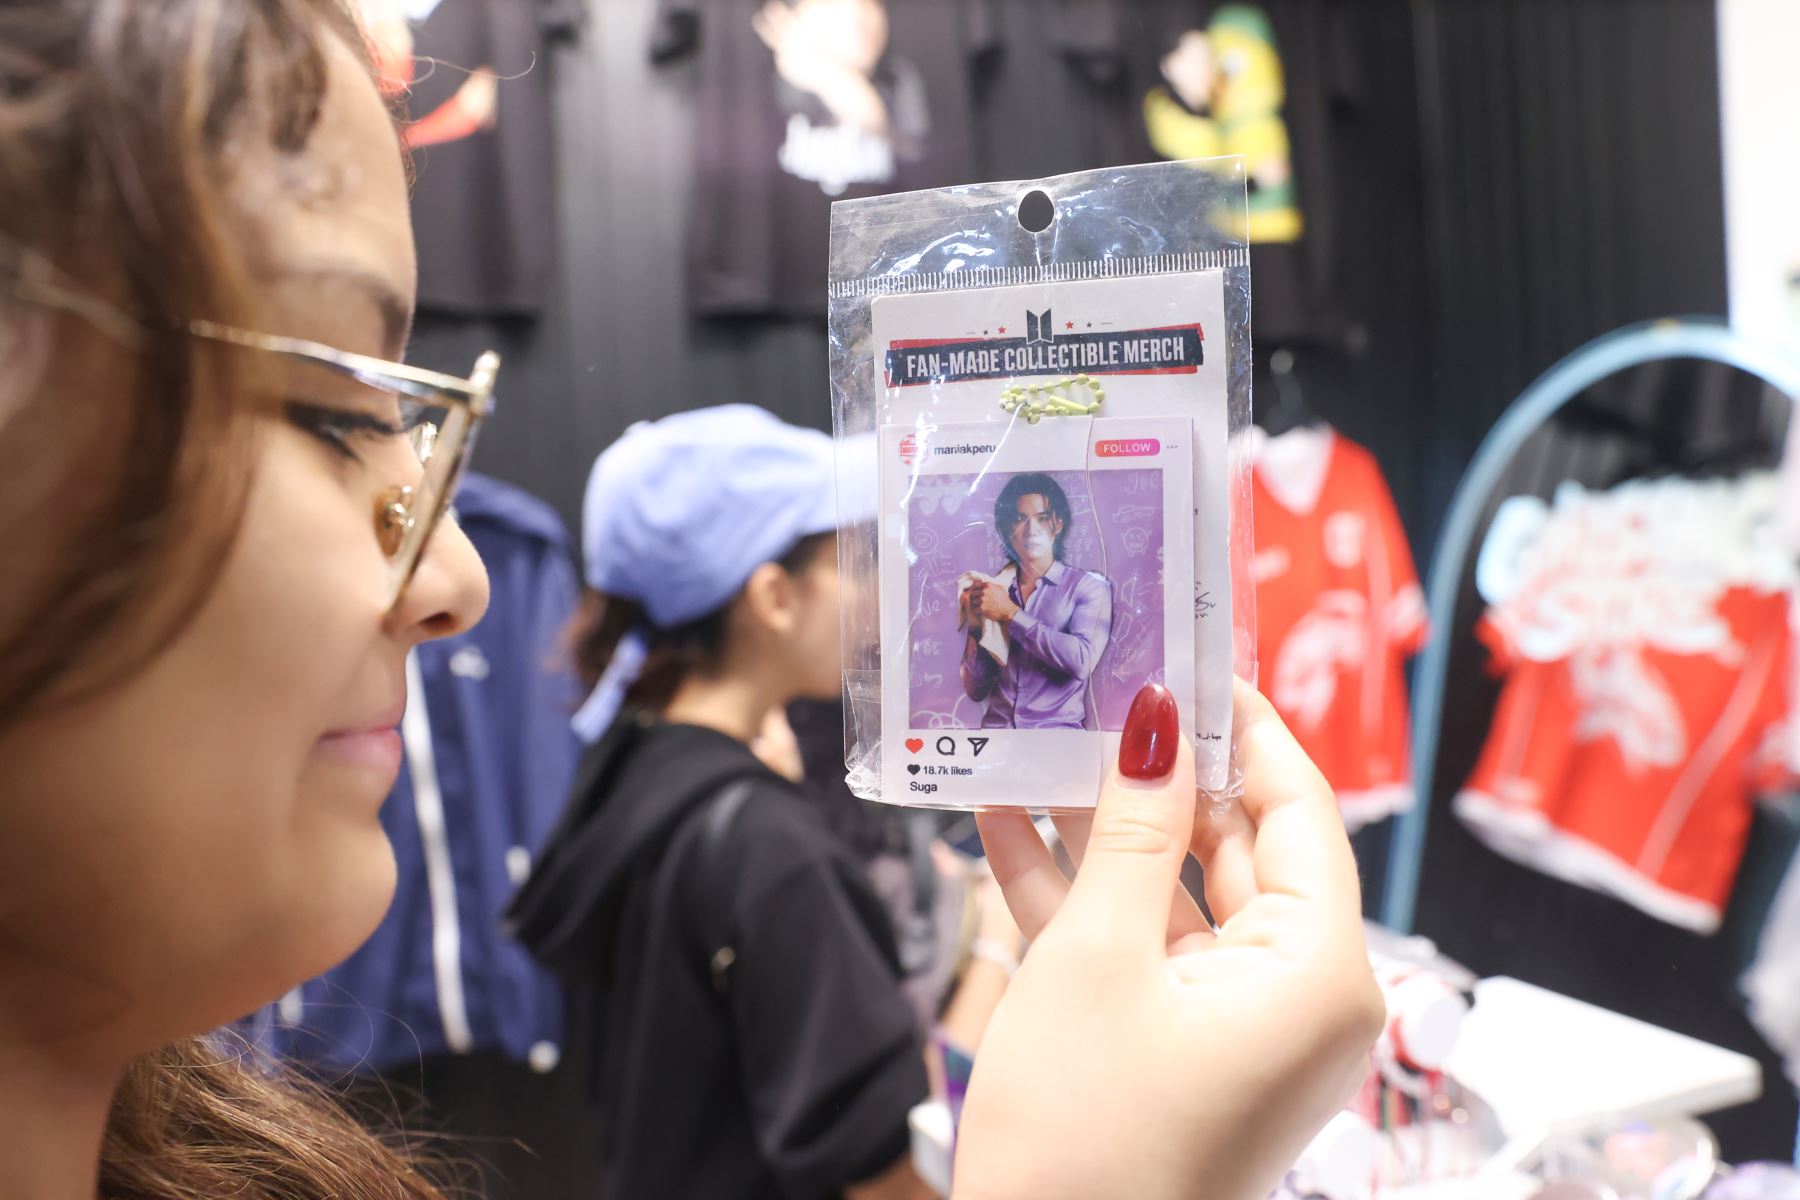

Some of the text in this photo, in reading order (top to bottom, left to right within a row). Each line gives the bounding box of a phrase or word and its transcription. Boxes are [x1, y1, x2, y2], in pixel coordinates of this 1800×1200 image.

[906, 336, 1185, 378] FAN-MADE COLLECTIBLE MERCH
[934, 443, 997, 456] maniakperu
[1103, 442, 1151, 454] FOLLOW
[923, 765, 973, 776] 18.7k likes
[910, 781, 938, 794] Suga
